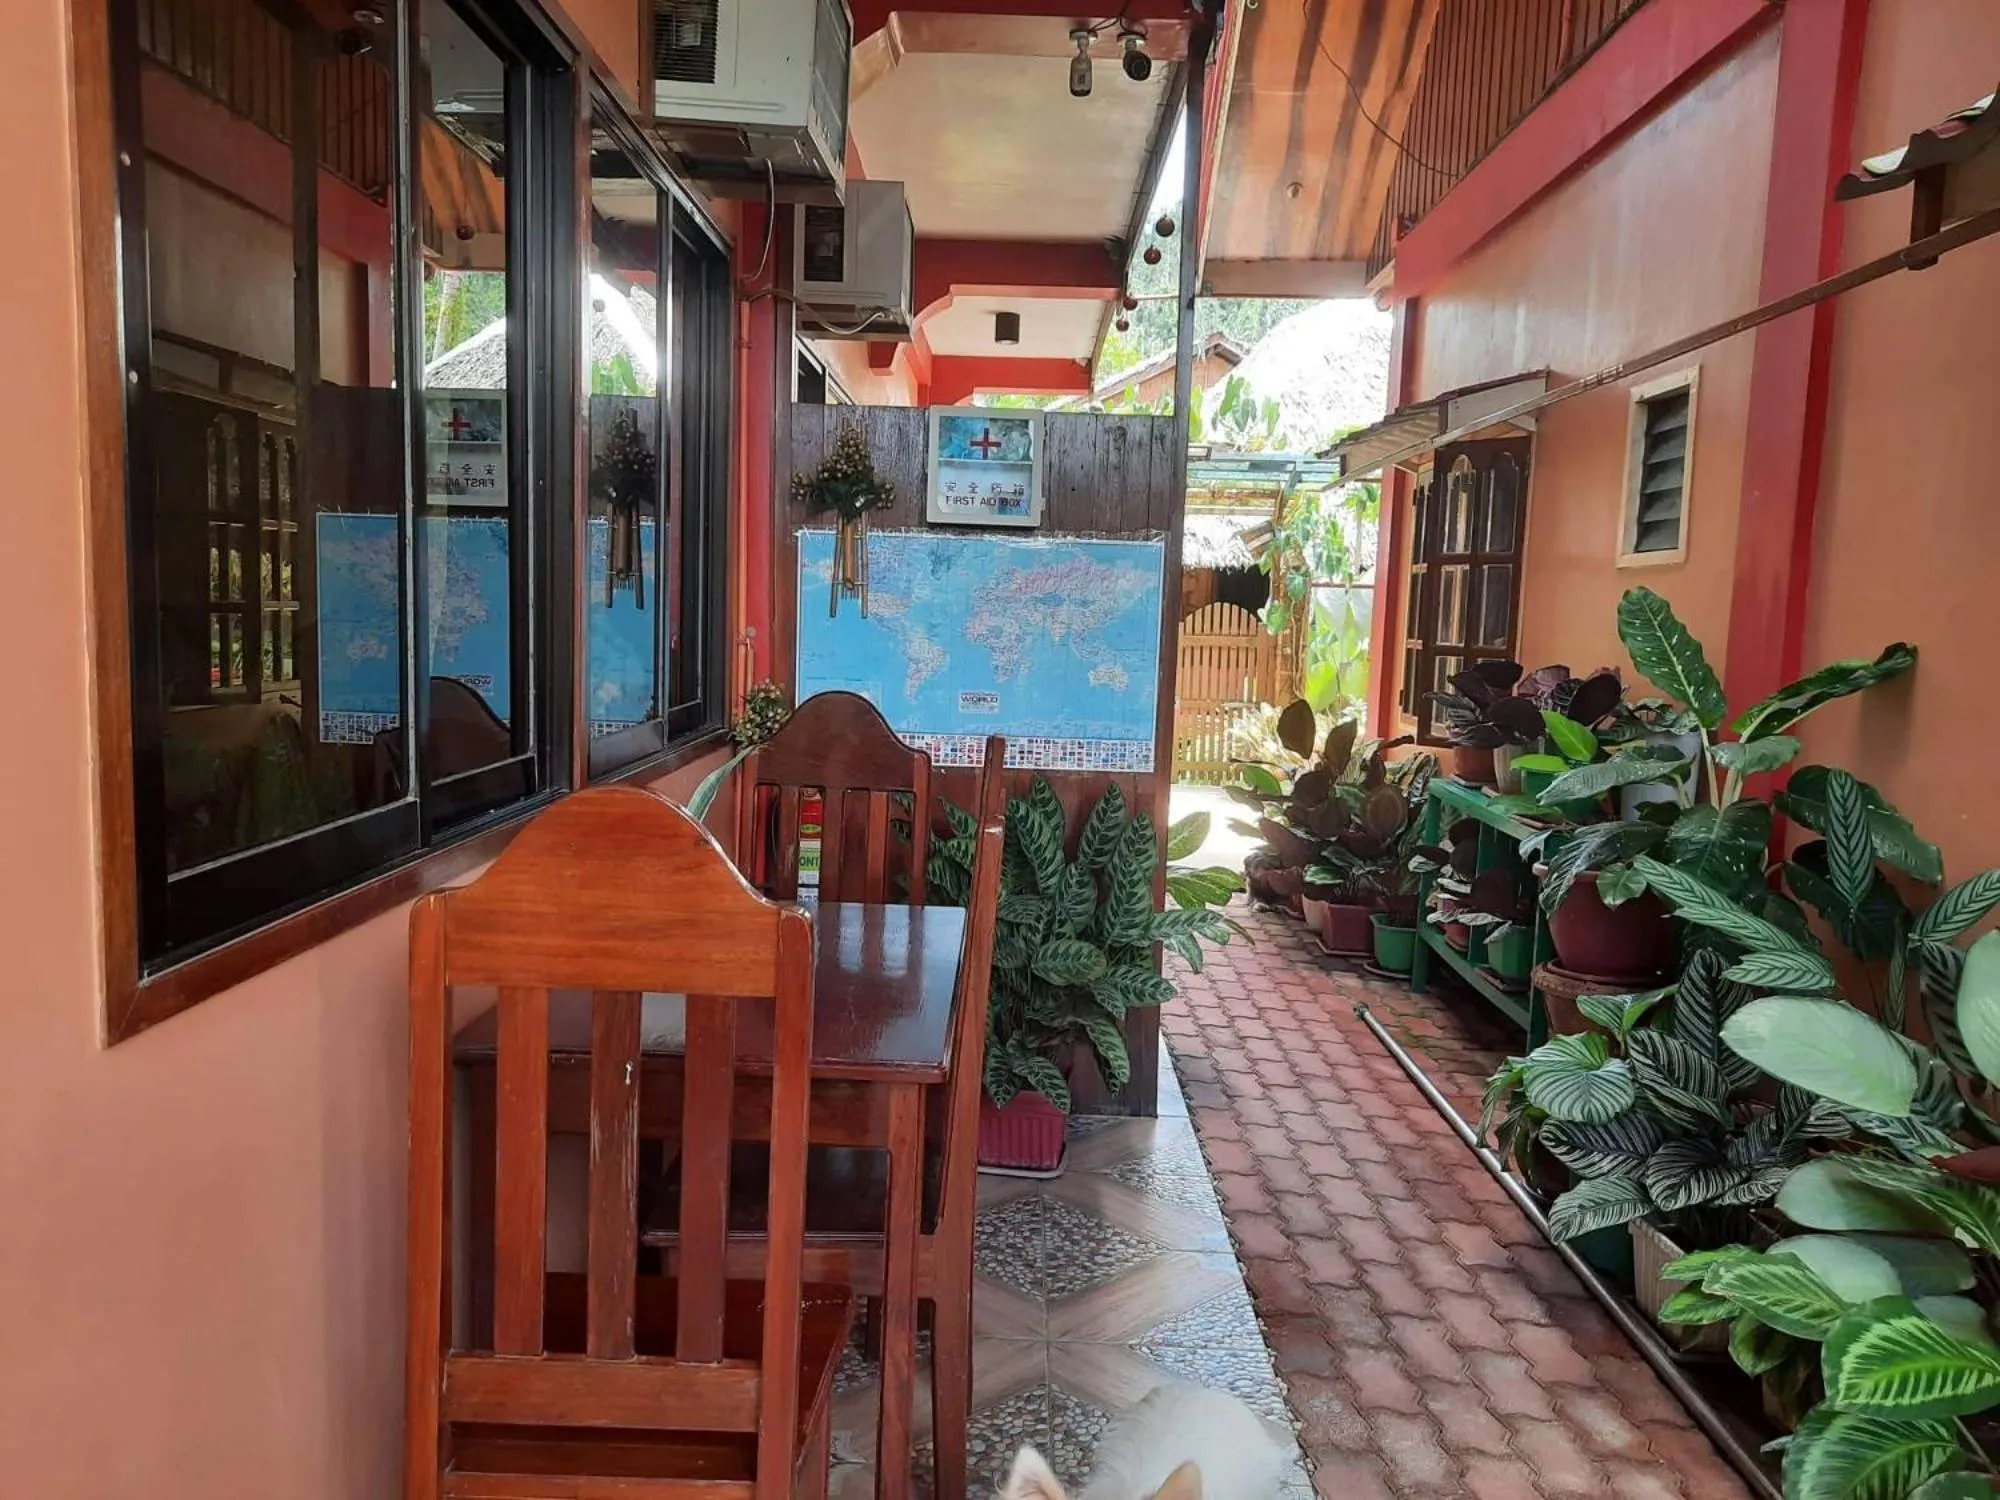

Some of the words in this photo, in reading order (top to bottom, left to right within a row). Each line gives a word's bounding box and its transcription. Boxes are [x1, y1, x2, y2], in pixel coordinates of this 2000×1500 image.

[946, 495, 975, 506] FIRST
[980, 496, 997, 507] AID
[999, 497, 1021, 508] BOX
[961, 695, 998, 704] WORLD
